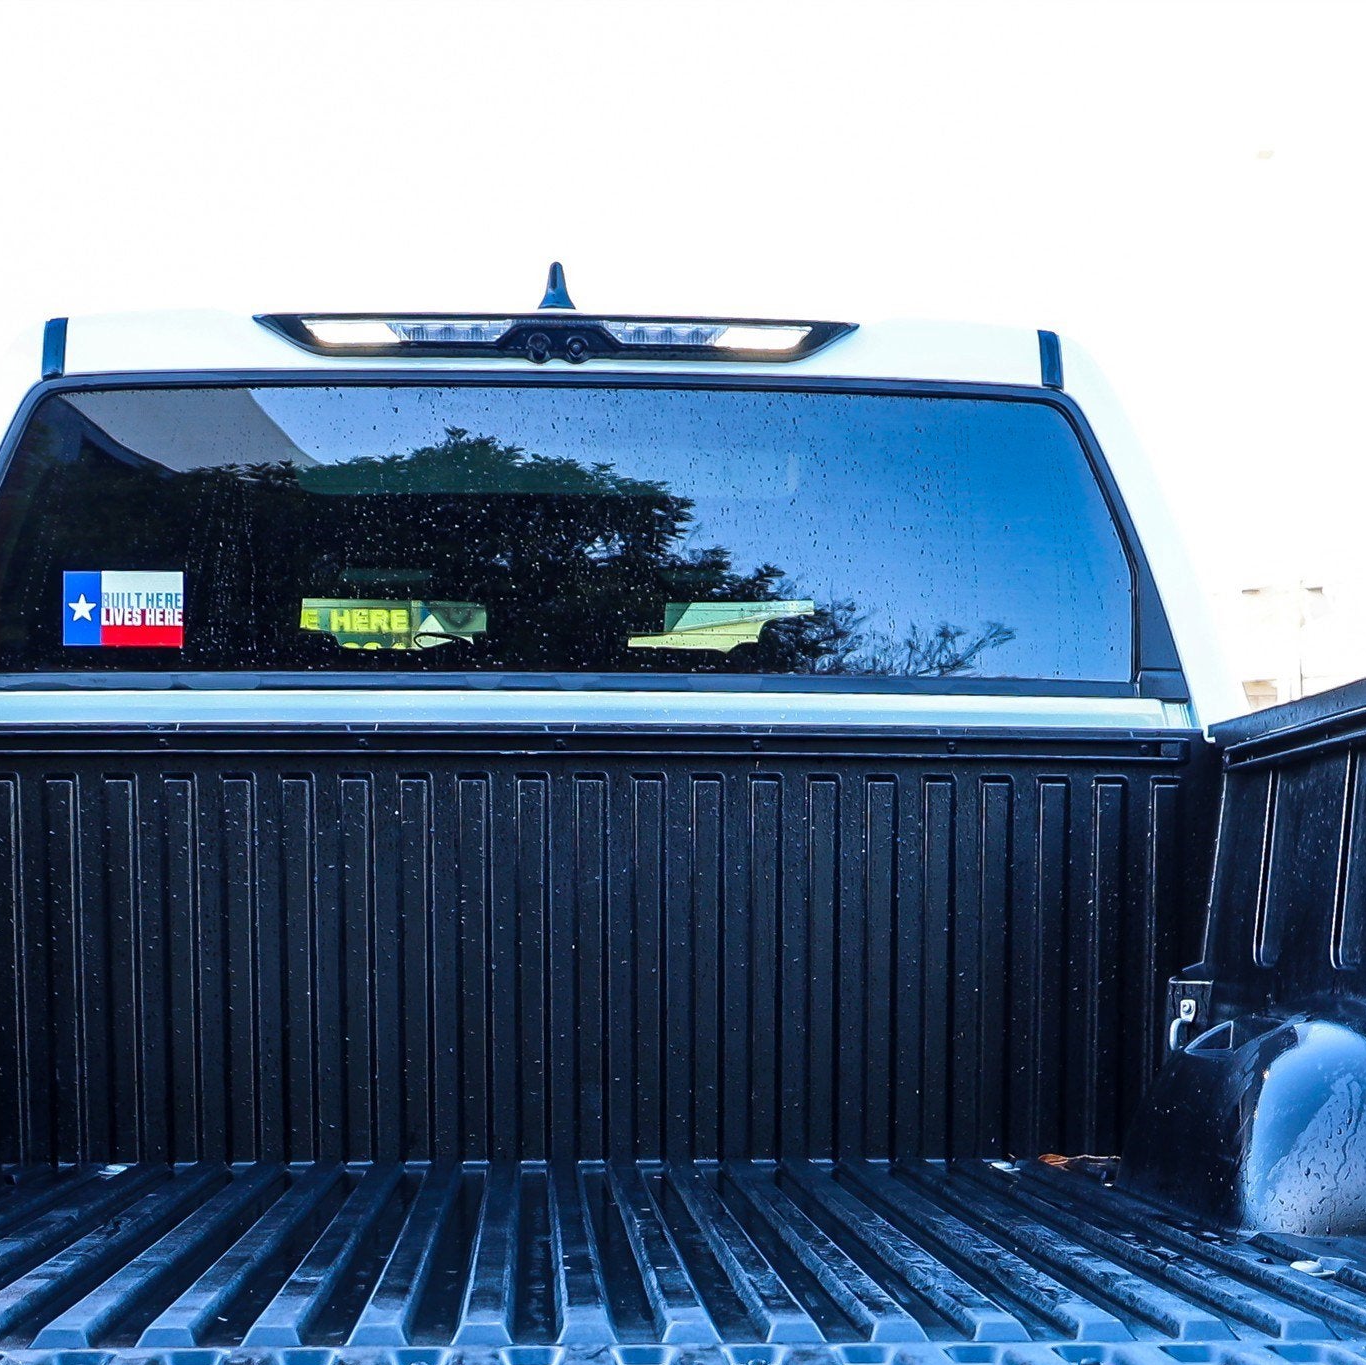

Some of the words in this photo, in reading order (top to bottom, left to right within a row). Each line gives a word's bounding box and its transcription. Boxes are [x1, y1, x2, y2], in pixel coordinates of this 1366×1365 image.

[102, 592, 142, 609] BUILT
[146, 592, 182, 609] HERE
[101, 609, 143, 626] LIVES
[145, 609, 183, 626] HERE
[330, 609, 410, 632] HERE
